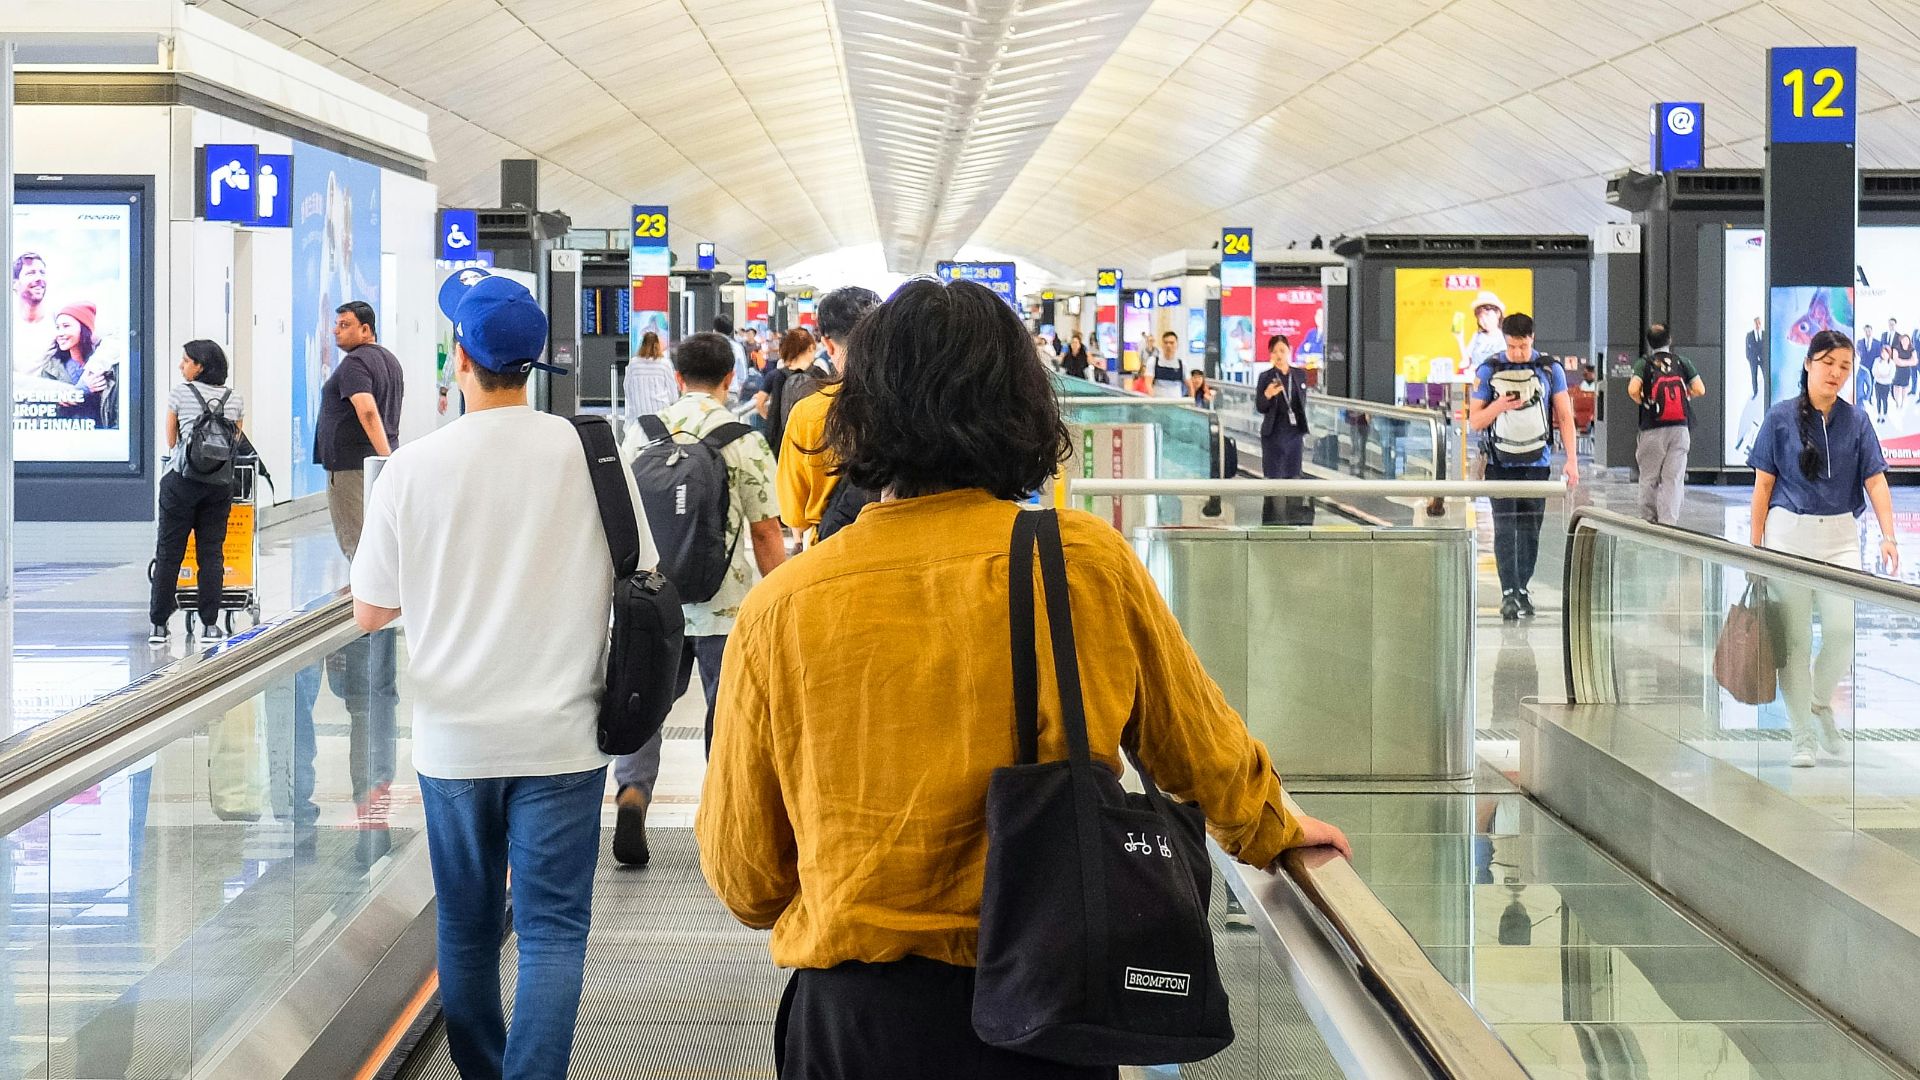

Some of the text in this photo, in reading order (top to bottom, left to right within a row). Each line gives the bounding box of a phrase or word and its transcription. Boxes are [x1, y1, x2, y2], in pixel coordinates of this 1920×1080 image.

[1783, 68, 1844, 117] 12
[635, 213, 667, 238] 23
[1223, 233, 1251, 255] 24
[39, 418, 96, 431] FINNAIR
[1128, 972, 1186, 990] BROMPTON
